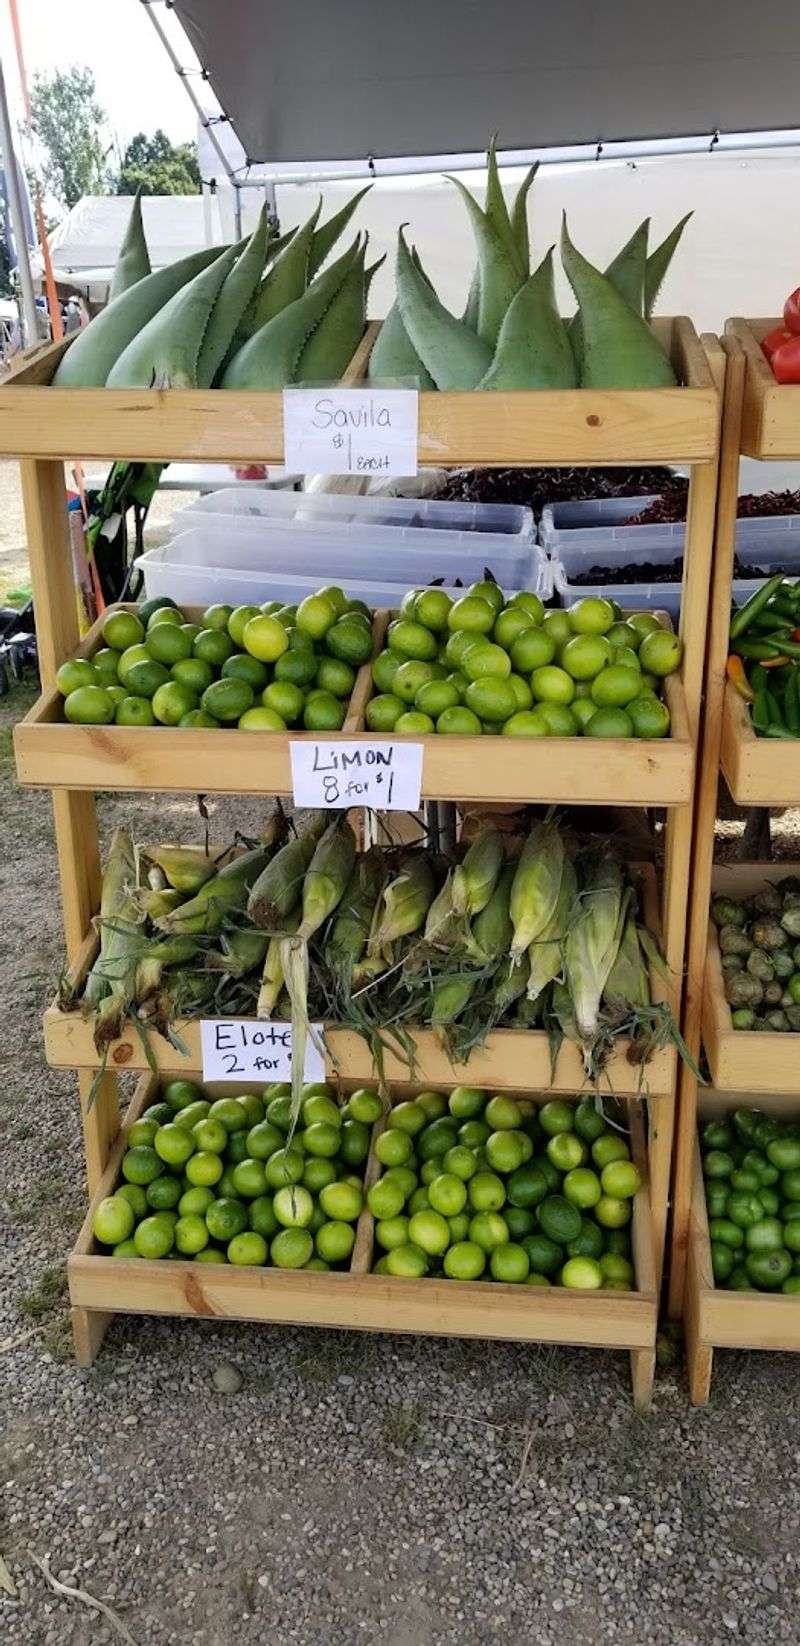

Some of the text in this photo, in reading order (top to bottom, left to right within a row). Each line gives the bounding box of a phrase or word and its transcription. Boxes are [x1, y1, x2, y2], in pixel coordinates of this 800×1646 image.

[312, 399, 391, 429] Savila
[323, 775, 340, 803] 8
[345, 780, 369, 797] for
[221, 1053, 246, 1074] 2
[253, 1056, 280, 1071] for
